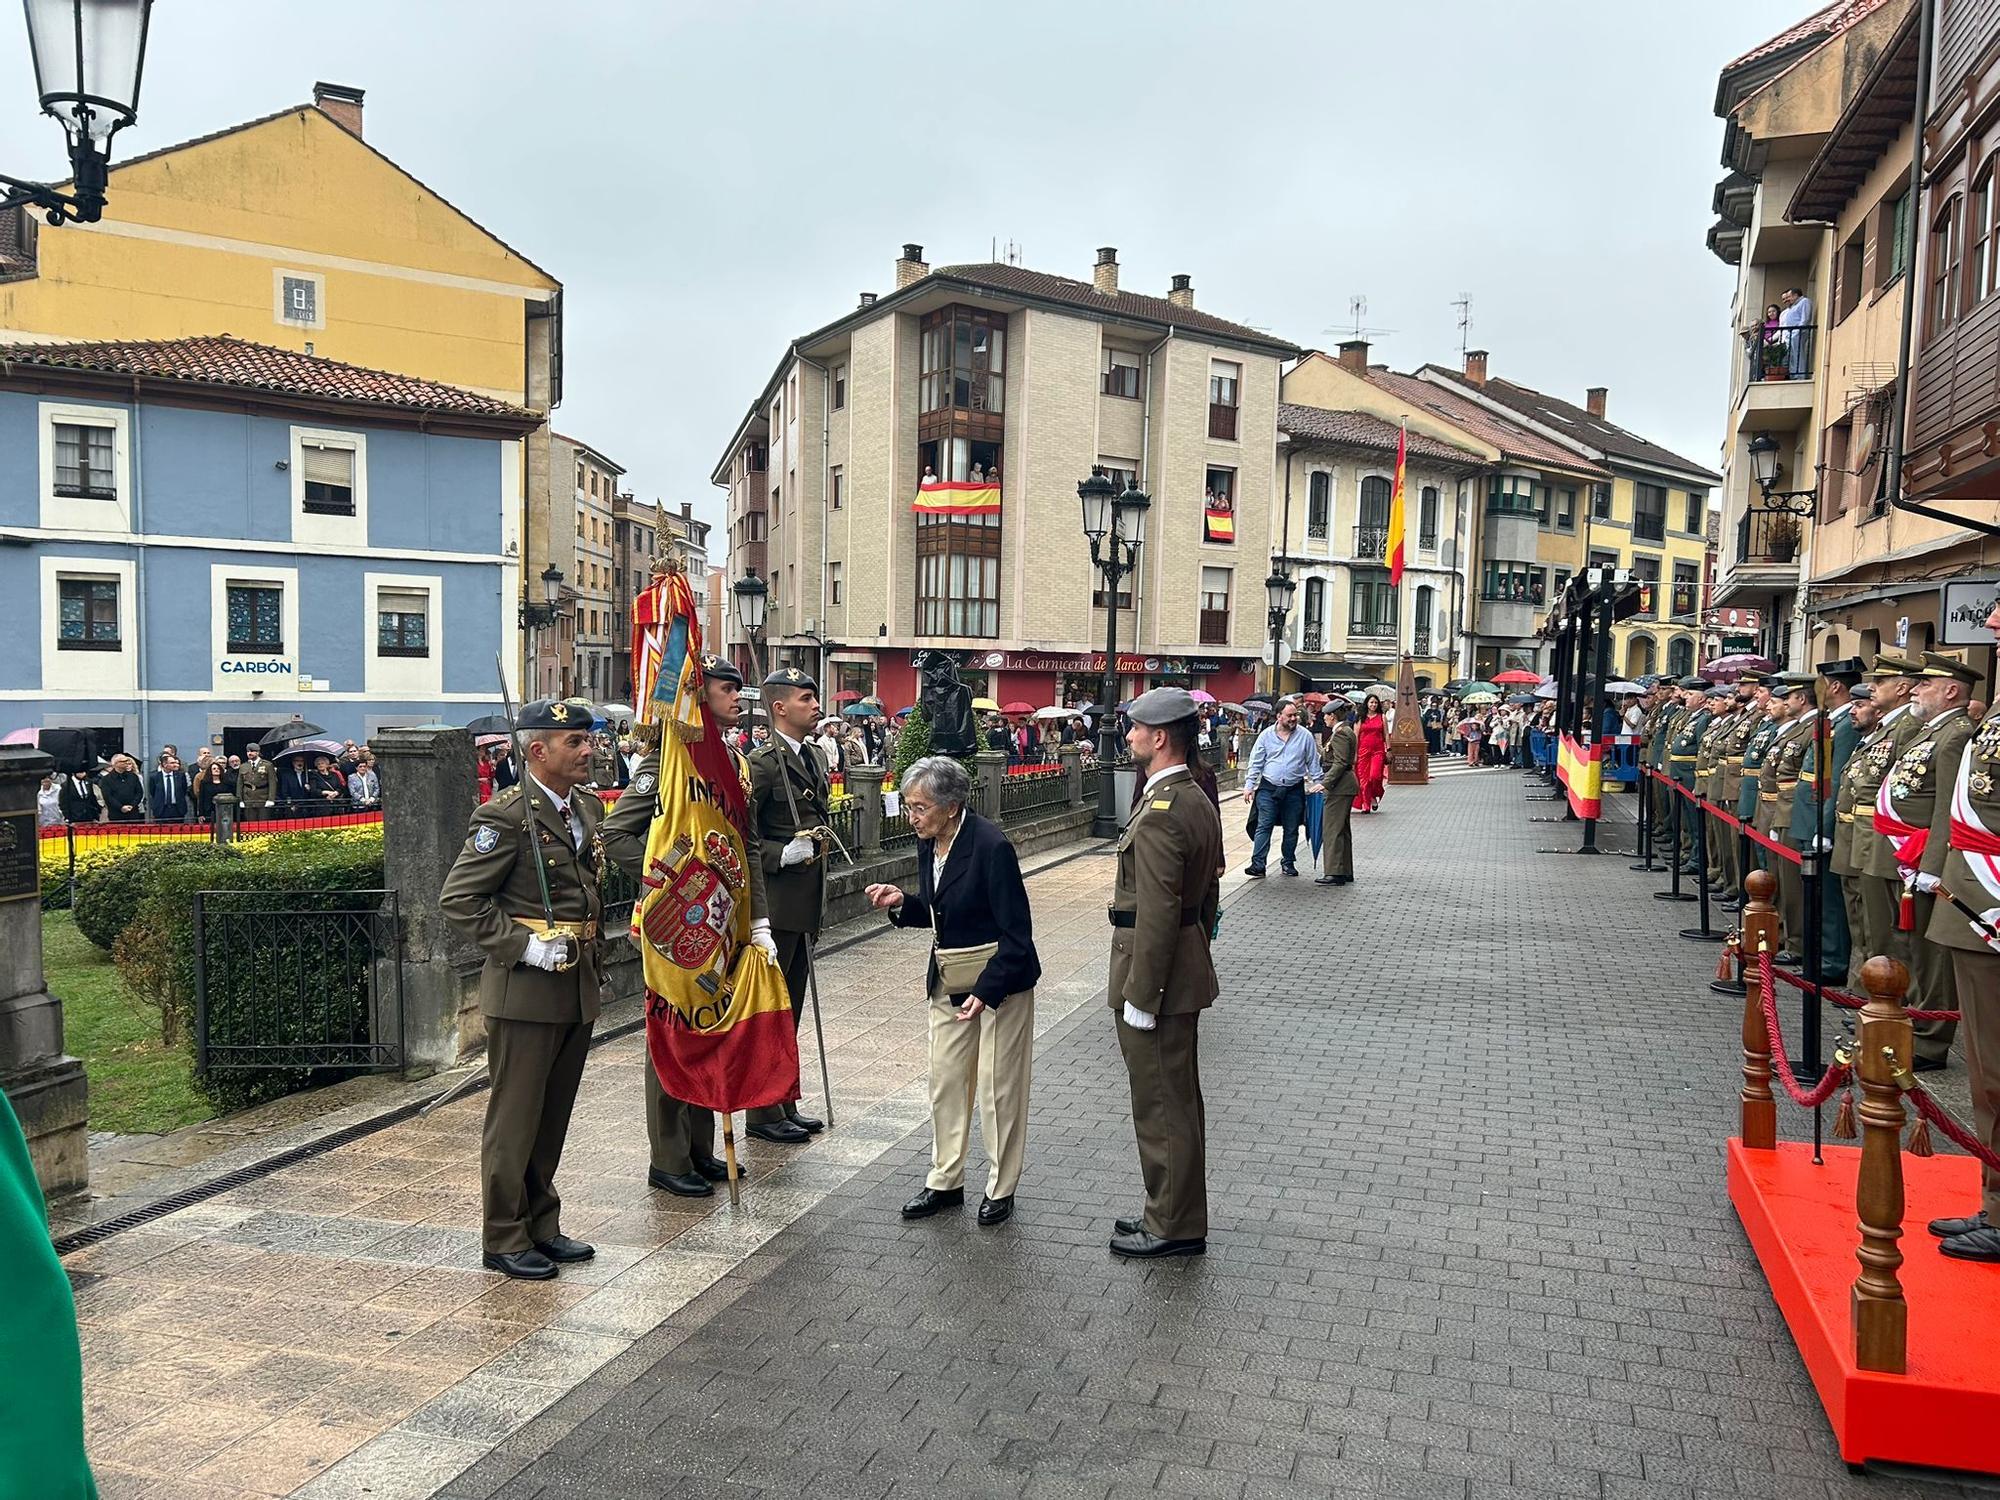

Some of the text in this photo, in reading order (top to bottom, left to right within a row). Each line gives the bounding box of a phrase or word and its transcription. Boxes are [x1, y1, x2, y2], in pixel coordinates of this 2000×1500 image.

[220, 659, 292, 674] CARBÓN
[1006, 655, 1022, 669] La
[1025, 655, 1091, 670] Carnicería
[1094, 656, 1107, 671] de
